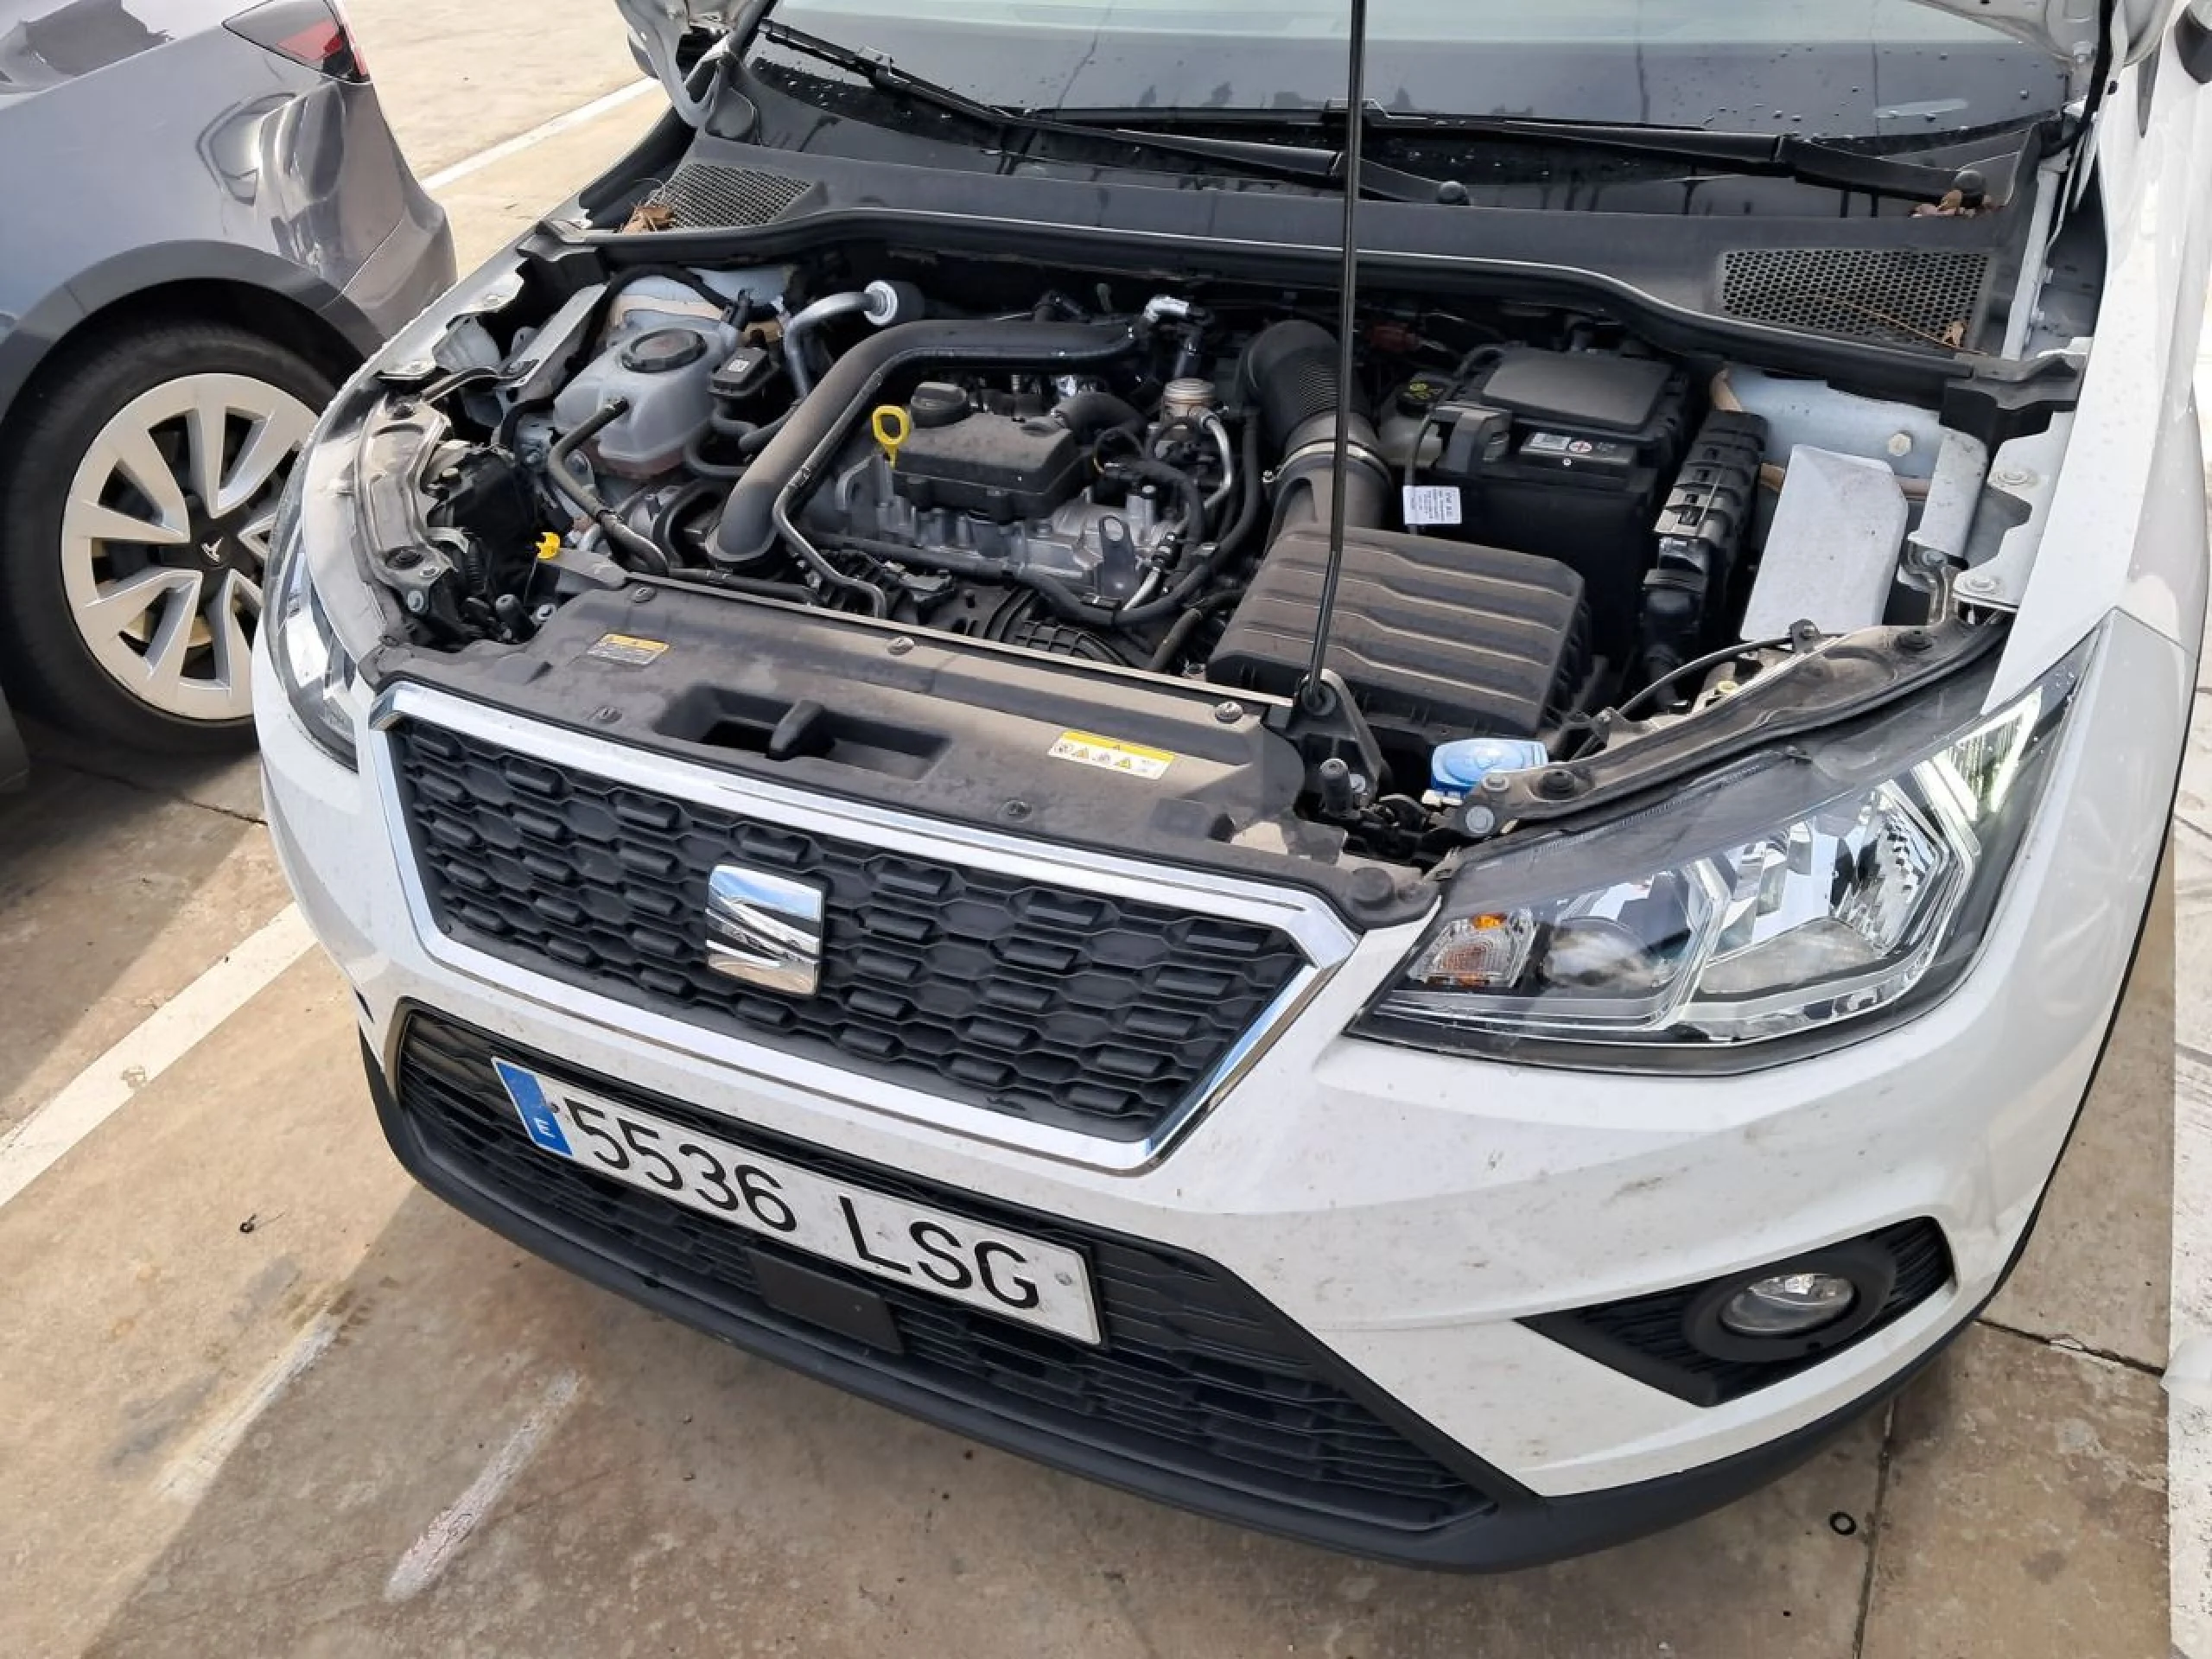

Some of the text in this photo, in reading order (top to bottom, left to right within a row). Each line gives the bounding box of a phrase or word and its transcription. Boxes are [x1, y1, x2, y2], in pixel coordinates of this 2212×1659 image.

[534, 1117, 555, 1139] E
[563, 1097, 1039, 1309] 5536 LSG
